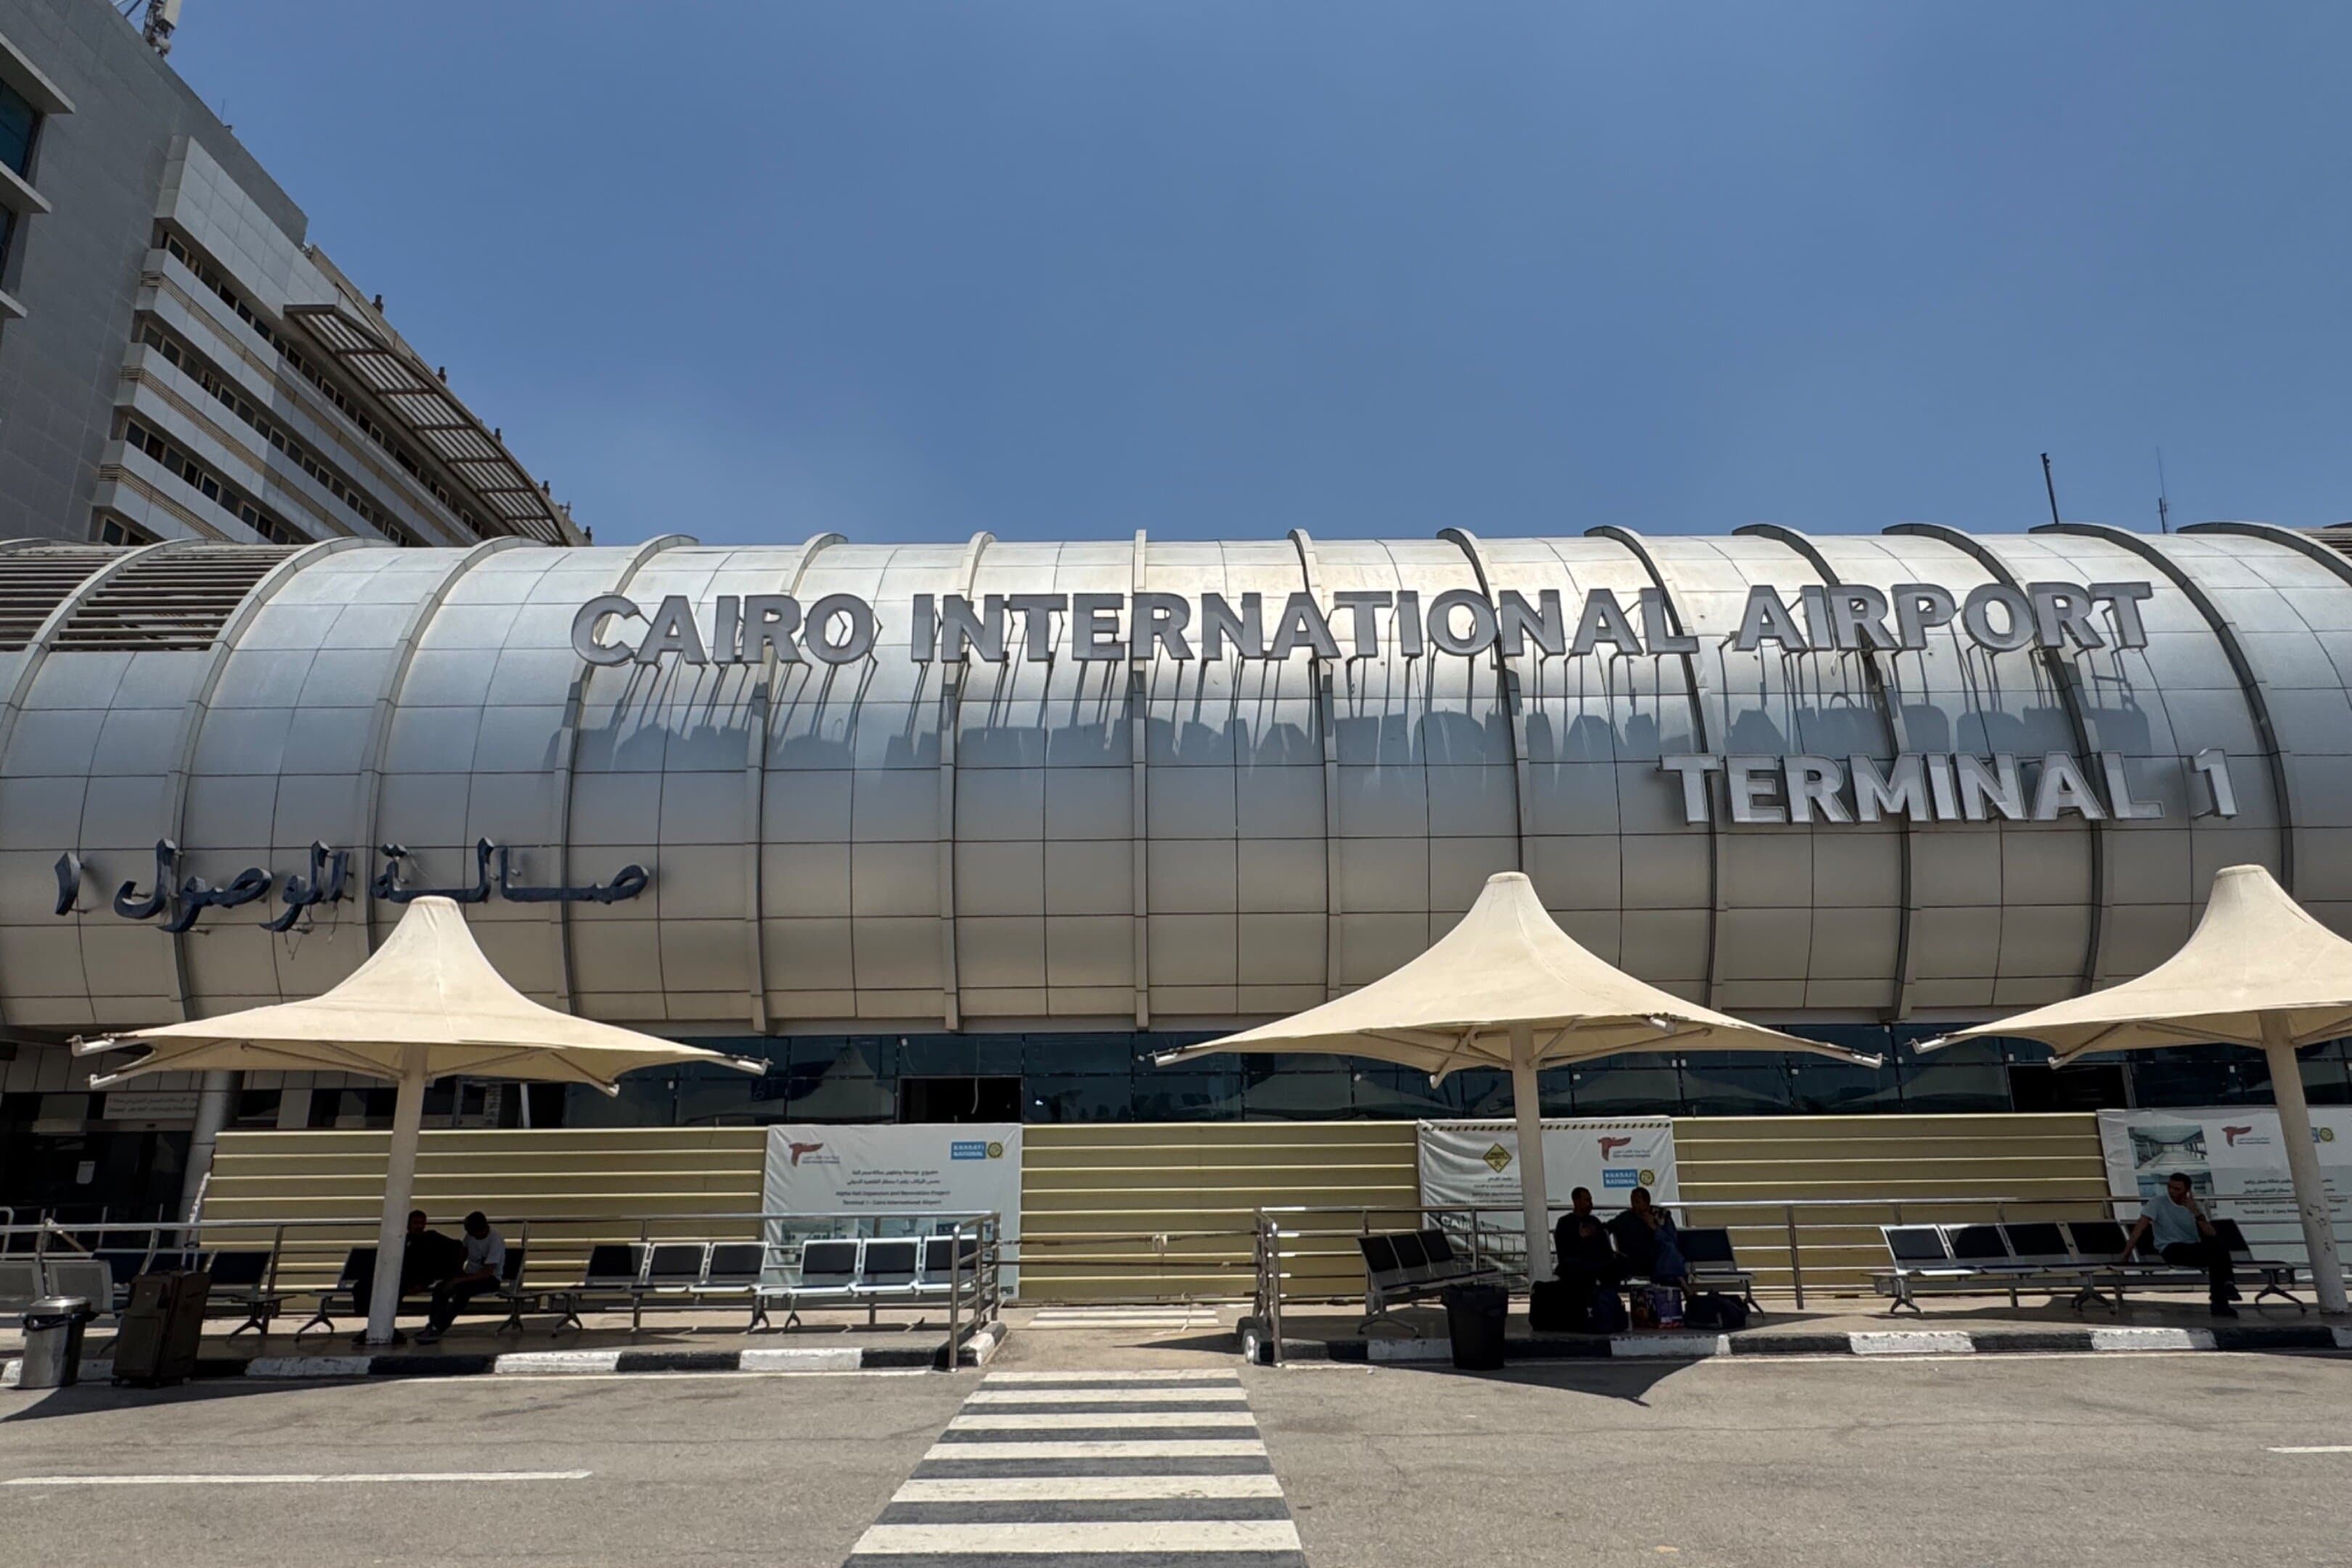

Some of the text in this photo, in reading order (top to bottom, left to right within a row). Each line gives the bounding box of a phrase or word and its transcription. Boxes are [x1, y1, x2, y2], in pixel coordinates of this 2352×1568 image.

[571, 581, 2154, 664] CAIRO INTERNATIONAL AIRPORT
[1659, 748, 2239, 824] TERMINAL 1
[114, 838, 349, 934] الوصول
[369, 837, 649, 905] صالة
